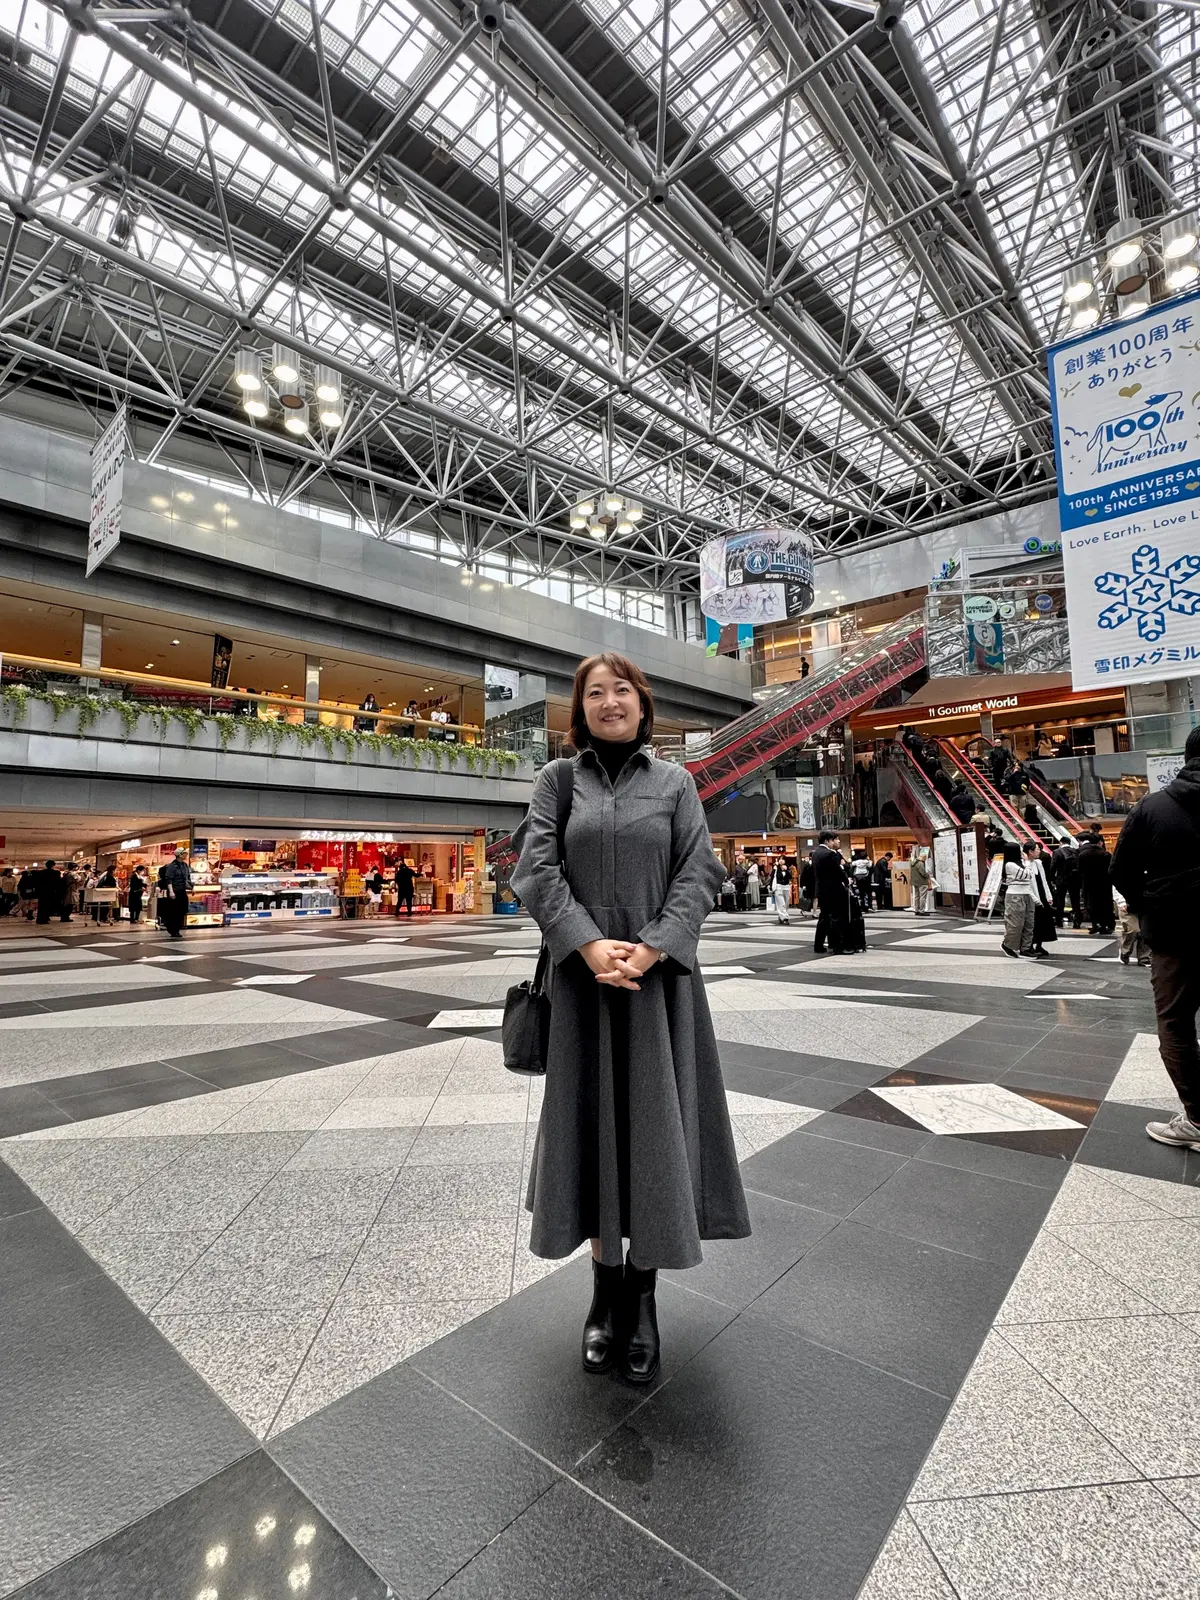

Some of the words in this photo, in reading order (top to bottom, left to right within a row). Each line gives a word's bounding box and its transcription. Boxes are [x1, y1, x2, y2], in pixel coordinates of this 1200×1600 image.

[1064, 316, 1194, 376] 創業100周年
[1088, 348, 1172, 389] ありがとう
[1106, 406, 1184, 442] 100th
[1091, 440, 1188, 475] Anniversary
[1069, 495, 1103, 510] 100th
[1104, 495, 1147, 513] SINCE
[1150, 486, 1180, 501] 1925
[1069, 535, 1099, 549] Love
[1104, 524, 1146, 541] Earth.
[1153, 514, 1186, 529] Love
[770, 552, 786, 564] THE
[937, 702, 982, 716] Gourmet
[985, 696, 1018, 709] World
